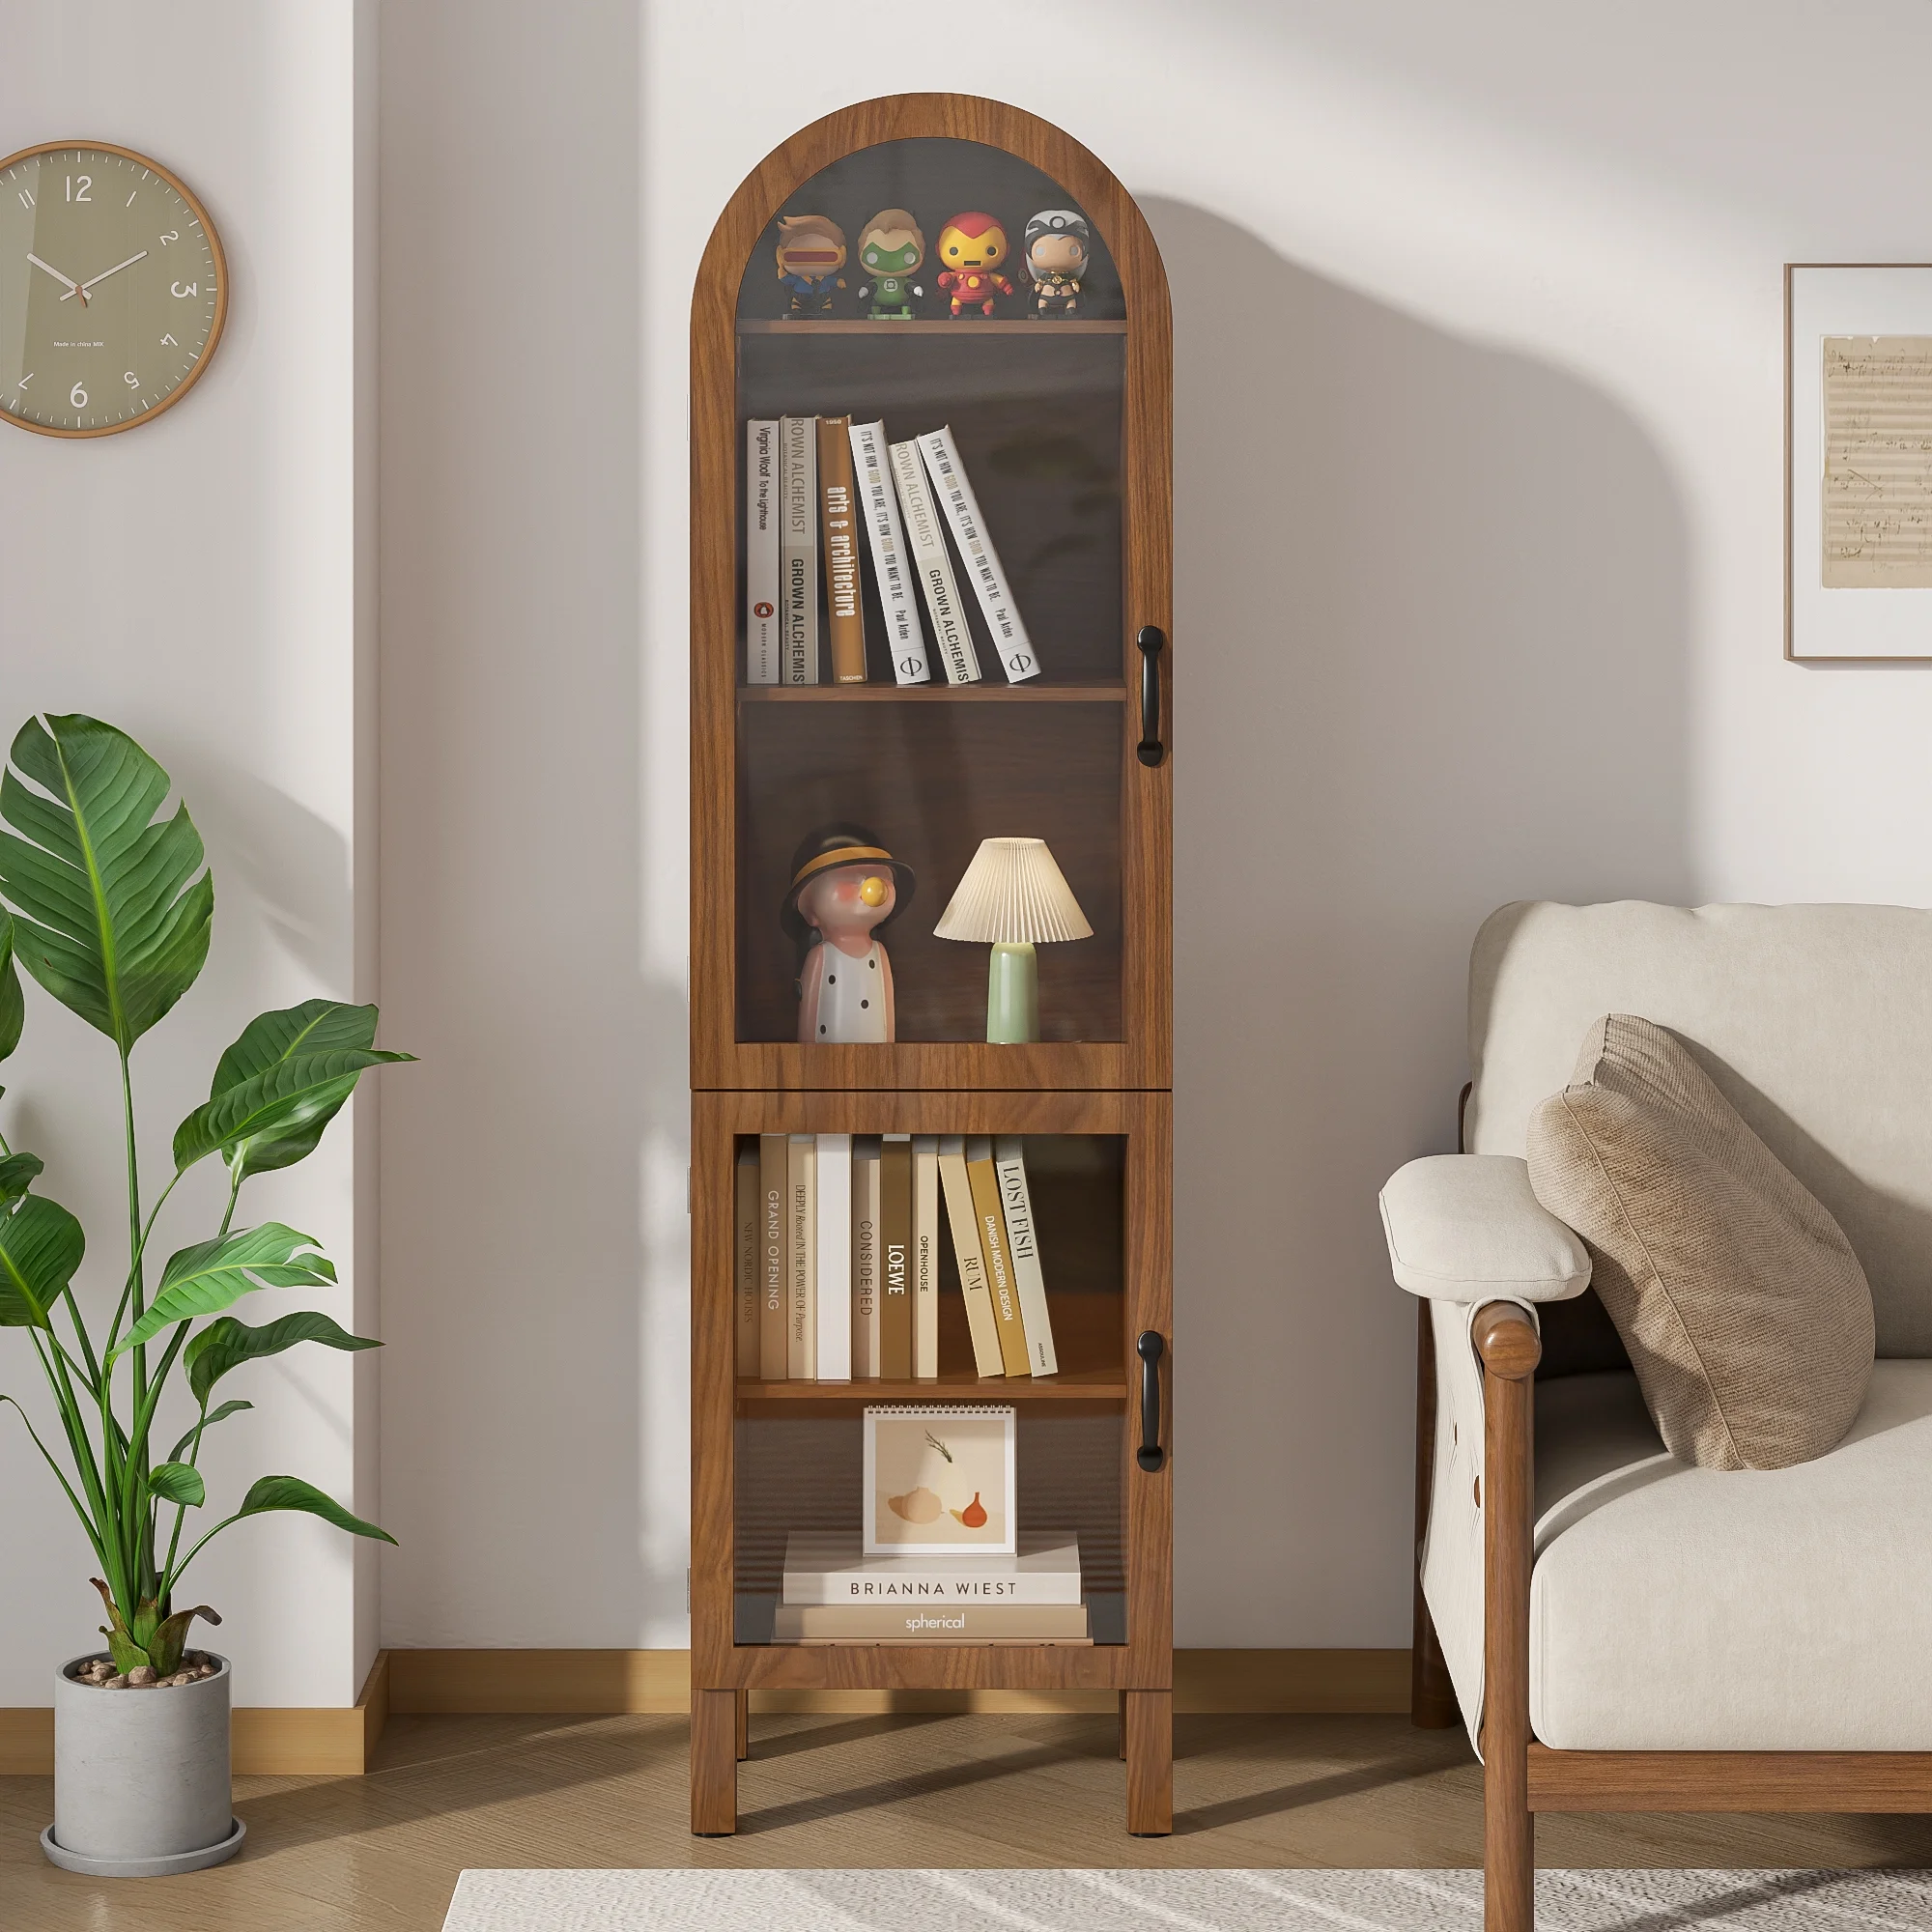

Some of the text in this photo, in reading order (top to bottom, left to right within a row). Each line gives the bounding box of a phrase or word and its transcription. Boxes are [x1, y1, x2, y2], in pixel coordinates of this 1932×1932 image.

[66, 175, 93, 203] 12
[158, 230, 180, 246] 2
[170, 280, 197, 298] 3
[159, 332, 179, 347] 4
[17, 372, 35, 390] 7
[124, 371, 141, 390] 5
[70, 381, 89, 409] 6
[756, 427, 771, 455] Virginia
[861, 431, 873, 441] IT'S
[863, 442, 875, 453] NOT
[934, 448, 949, 462] NOT
[759, 456, 771, 477] Woolf
[866, 455, 878, 468] HOW
[938, 461, 953, 475] HOW
[867, 469, 881, 483] GOOD
[944, 474, 958, 491] GOOD
[759, 488, 769, 498] the
[791, 462, 806, 535] ALCHEMIST
[827, 487, 850, 513] arts
[870, 485, 884, 497] YOU
[950, 489, 964, 502] YOU
[756, 498, 769, 530] Lighthouse
[906, 483, 935, 548] ALCHEMIST
[878, 524, 892, 536] HOW
[963, 526, 979, 540] HOW
[881, 537, 895, 553] GOOD
[969, 540, 983, 555] GOOD
[884, 554, 896, 565] YOU
[975, 554, 988, 567] YOU
[831, 535, 857, 617] architecture
[887, 566, 900, 582] WANT
[980, 566, 995, 583] WANT
[985, 582, 998, 592] TO
[791, 558, 806, 684] GROWN ALCHEMIS
[895, 610, 911, 640] Paul Arden
[929, 569, 970, 683] GROWN ALCHEMIS
[995, 608, 1013, 639] Paul Arden
[1003, 1166, 1034, 1259] LOST FISH
[768, 1190, 780, 1310] GRAND OPENING
[743, 1221, 753, 1323] NEW NORDIC HOUSES
[793, 1184, 806, 1343] DEEPLY Rooted IN THE POWER OF Purpose.
[860, 1220, 873, 1316] CONSIDERED
[888, 1244, 905, 1295] LOEWE
[920, 1236, 928, 1293] OPENHOUSE
[984, 1215, 1013, 1321] DANISH MODERN DESIGN
[964, 1257, 982, 1292] RUM
[850, 1582, 1017, 1595] BRIANNA WIEST
[905, 1613, 965, 1633] spherical
